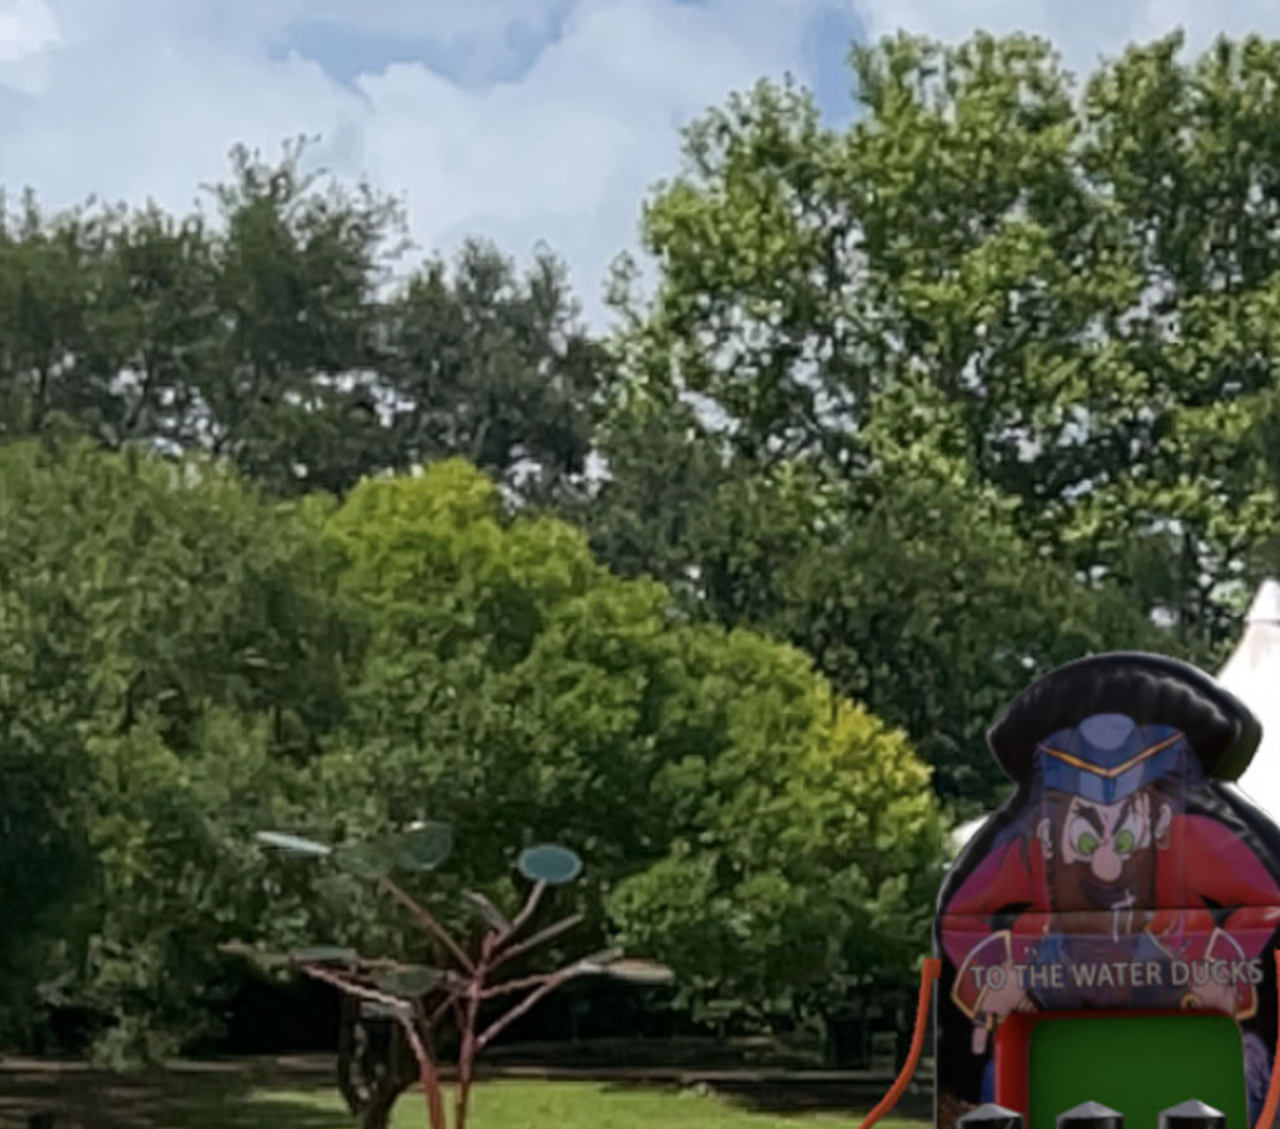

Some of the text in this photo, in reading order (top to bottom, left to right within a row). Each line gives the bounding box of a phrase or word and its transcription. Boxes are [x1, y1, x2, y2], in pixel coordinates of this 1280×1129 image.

[970, 958, 1264, 990] TO THE WATER DUCKS
